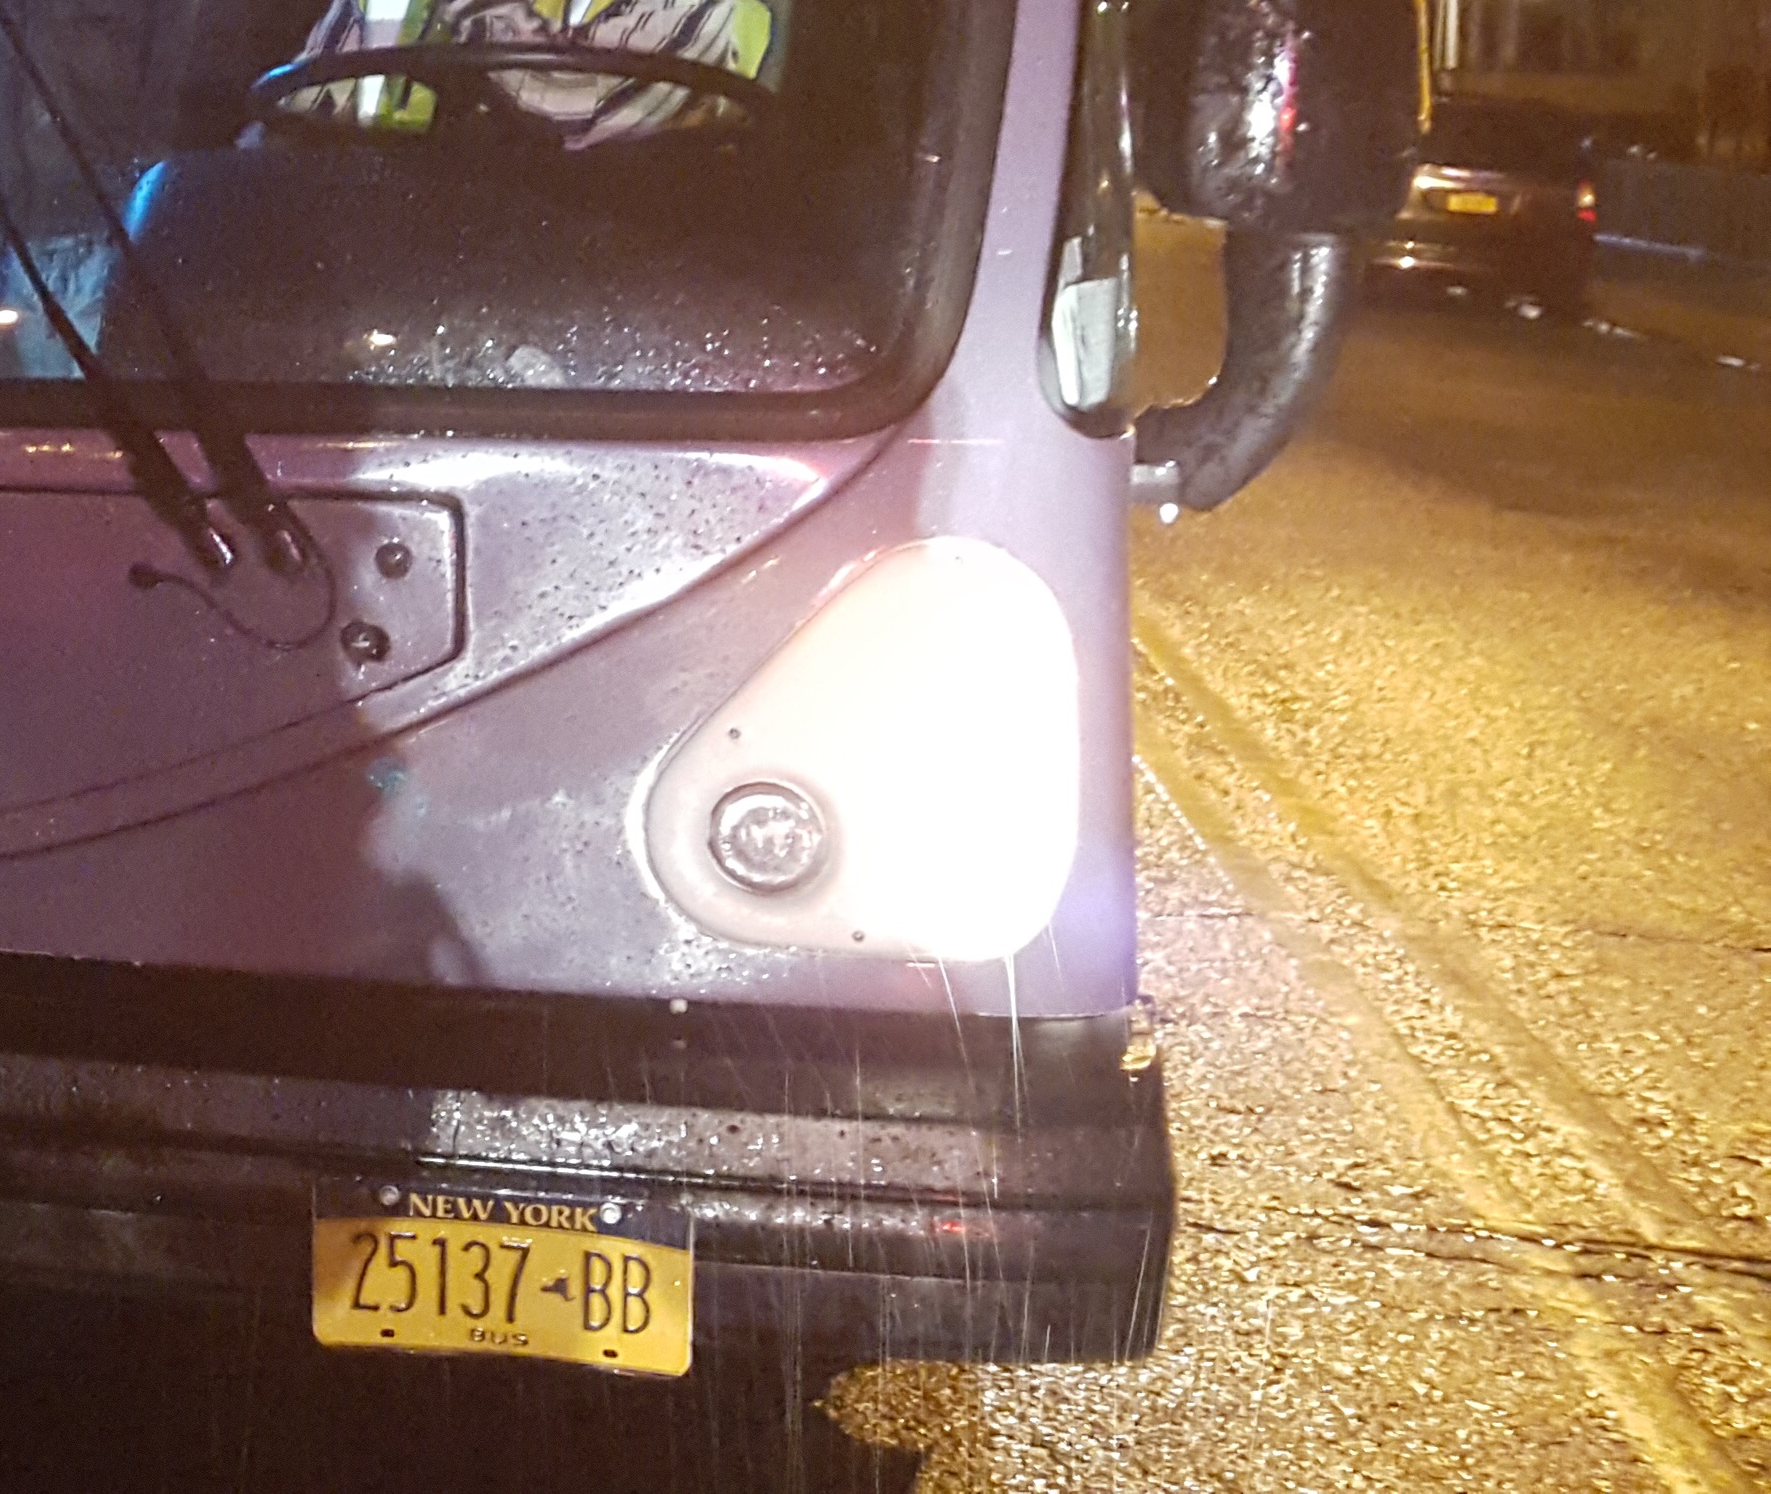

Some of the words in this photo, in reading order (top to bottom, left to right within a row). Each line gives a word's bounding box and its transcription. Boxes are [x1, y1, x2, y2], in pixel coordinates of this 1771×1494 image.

[408, 1192, 495, 1222] NEW
[503, 1201, 599, 1233] YORK
[350, 1230, 534, 1324] 25137
[581, 1249, 653, 1335] BB
[469, 1327, 530, 1347] BUS
